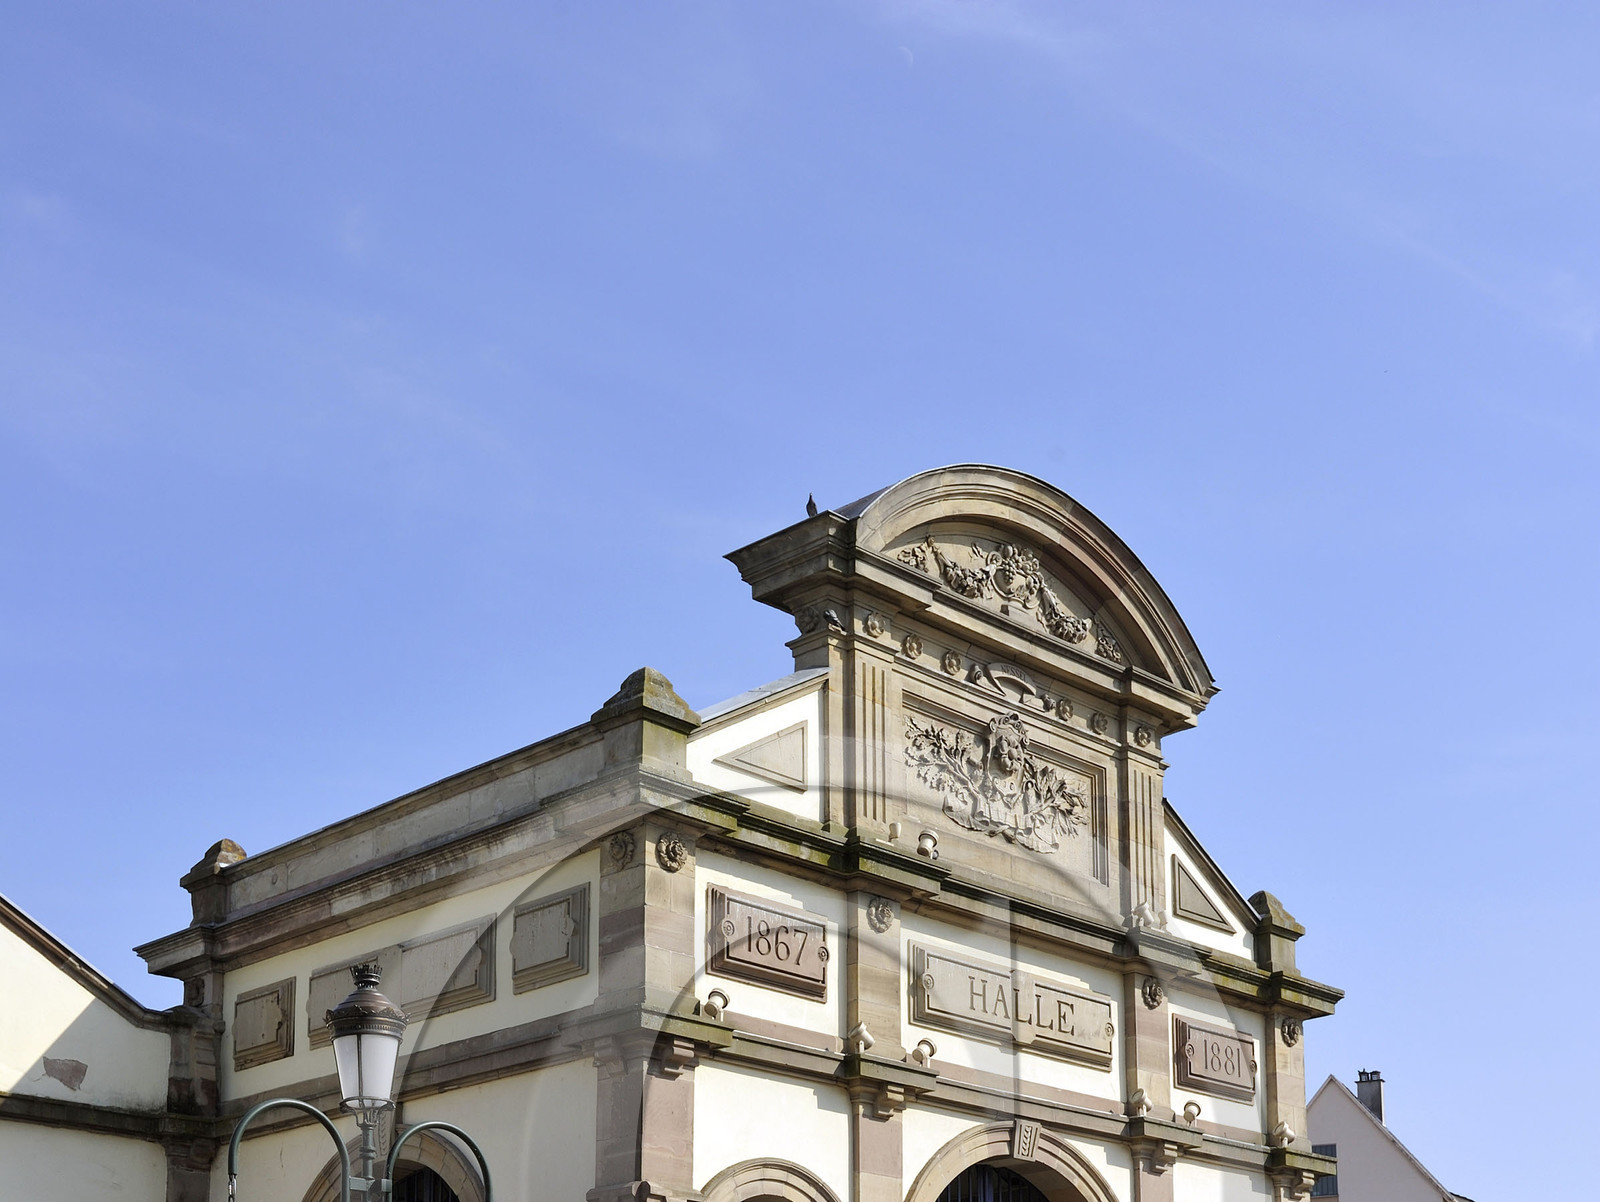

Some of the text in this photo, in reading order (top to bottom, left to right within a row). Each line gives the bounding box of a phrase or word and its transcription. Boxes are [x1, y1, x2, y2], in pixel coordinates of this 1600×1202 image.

[747, 915, 808, 966] 1867
[968, 976, 1075, 1036] HALLE
[1203, 1039, 1241, 1078] 1881
